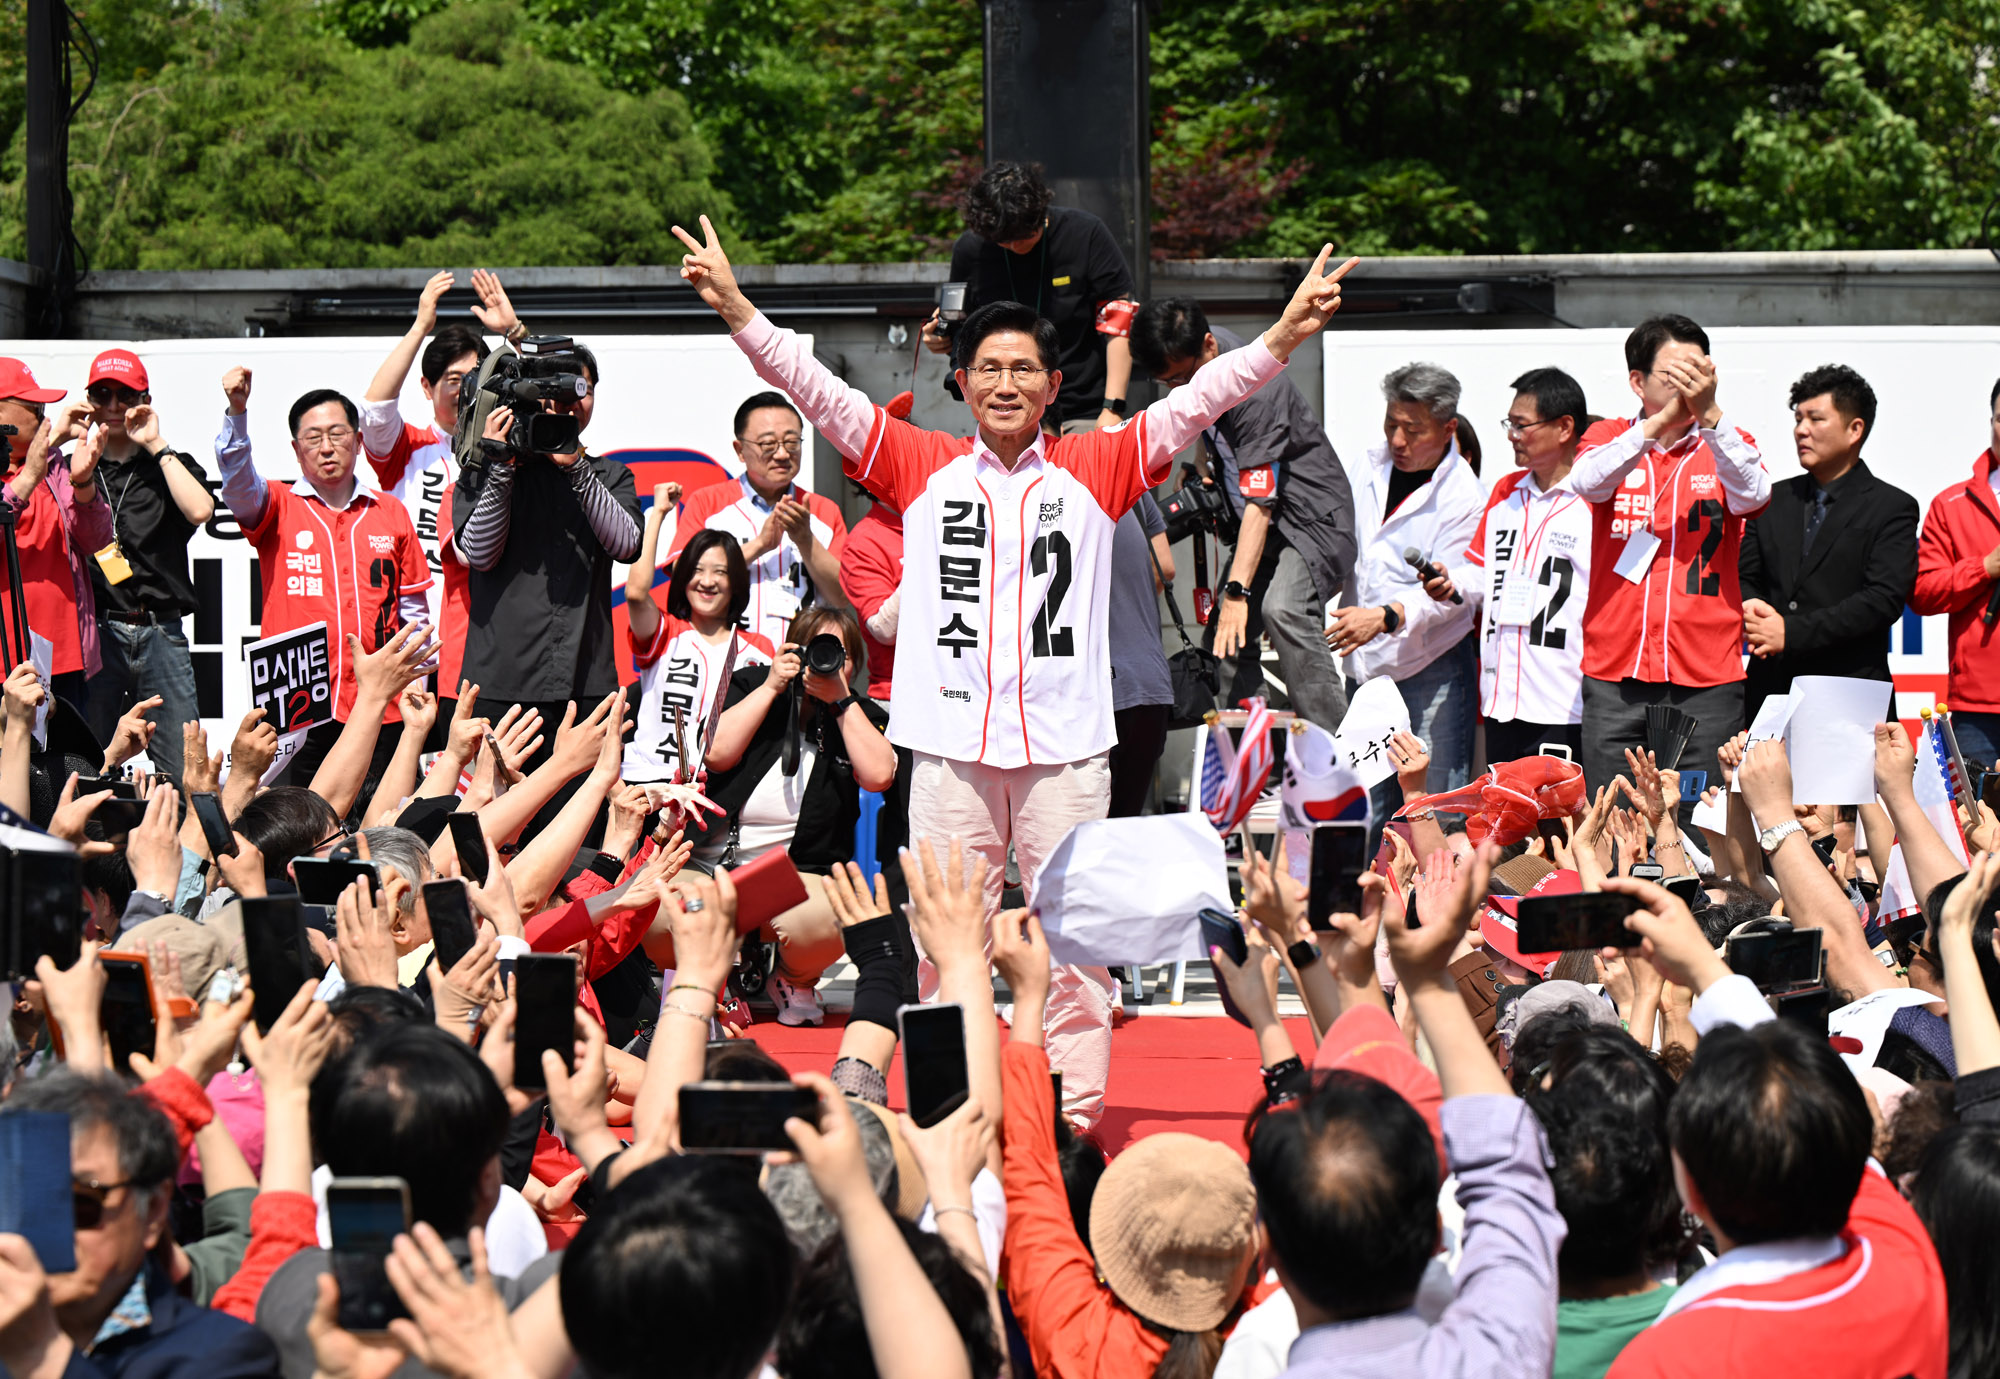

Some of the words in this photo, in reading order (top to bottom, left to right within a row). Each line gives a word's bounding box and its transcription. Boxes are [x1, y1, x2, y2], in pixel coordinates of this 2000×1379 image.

[113, 358, 133, 369] KOREA
[577, 383, 586, 391] KTV
[1690, 474, 1717, 483] PEOPLE
[1690, 482, 1716, 491] POWER
[1614, 493, 1650, 516] 국민
[368, 534, 396, 544] PEOPLE
[369, 541, 395, 551] POWER
[1549, 538, 1575, 550] POWER
[1550, 531, 1579, 544] PEOPLE
[1686, 499, 1724, 597] 2
[286, 552, 323, 575] 국민
[287, 575, 323, 597] 의힘
[937, 500, 986, 659] 김문수
[370, 558, 396, 648] 2
[1030, 530, 1075, 658] 2
[1529, 555, 1574, 650] 2
[941, 688, 969, 700] 국민의힘
[288, 690, 314, 732] 2
[655, 658, 698, 764] 김문수
